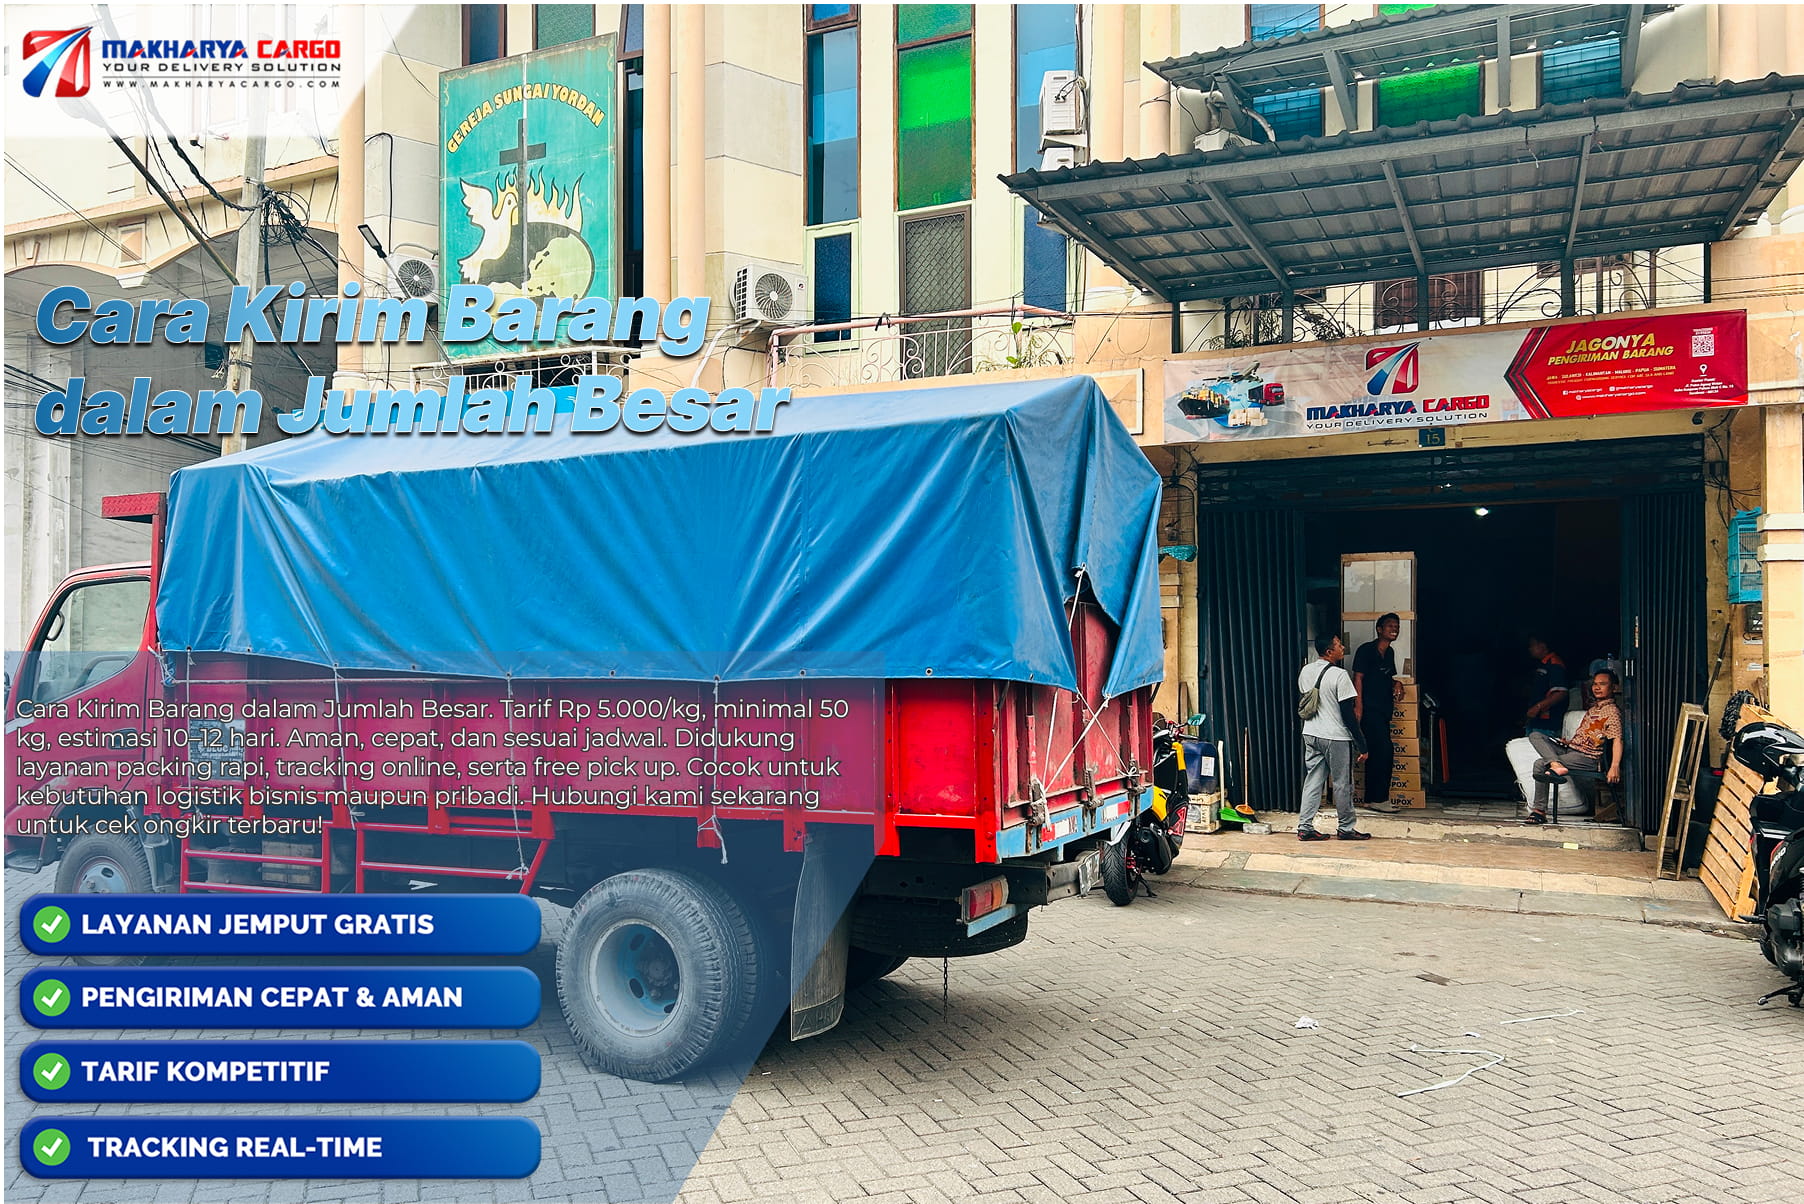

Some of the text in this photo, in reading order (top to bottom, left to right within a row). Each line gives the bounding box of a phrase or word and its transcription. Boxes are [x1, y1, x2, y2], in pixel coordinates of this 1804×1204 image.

[447, 83, 605, 153] GEREJA SUNGAI YORDAN
[1566, 333, 1655, 354] JAGONYA
[1547, 346, 1674, 366] PENGIRIMAN BARANG
[1306, 394, 1490, 421] MAKHARYA CARGO
[1306, 412, 1488, 431] YOUR DELIVERY SOLUTION
[1426, 433, 1441, 445] 15
